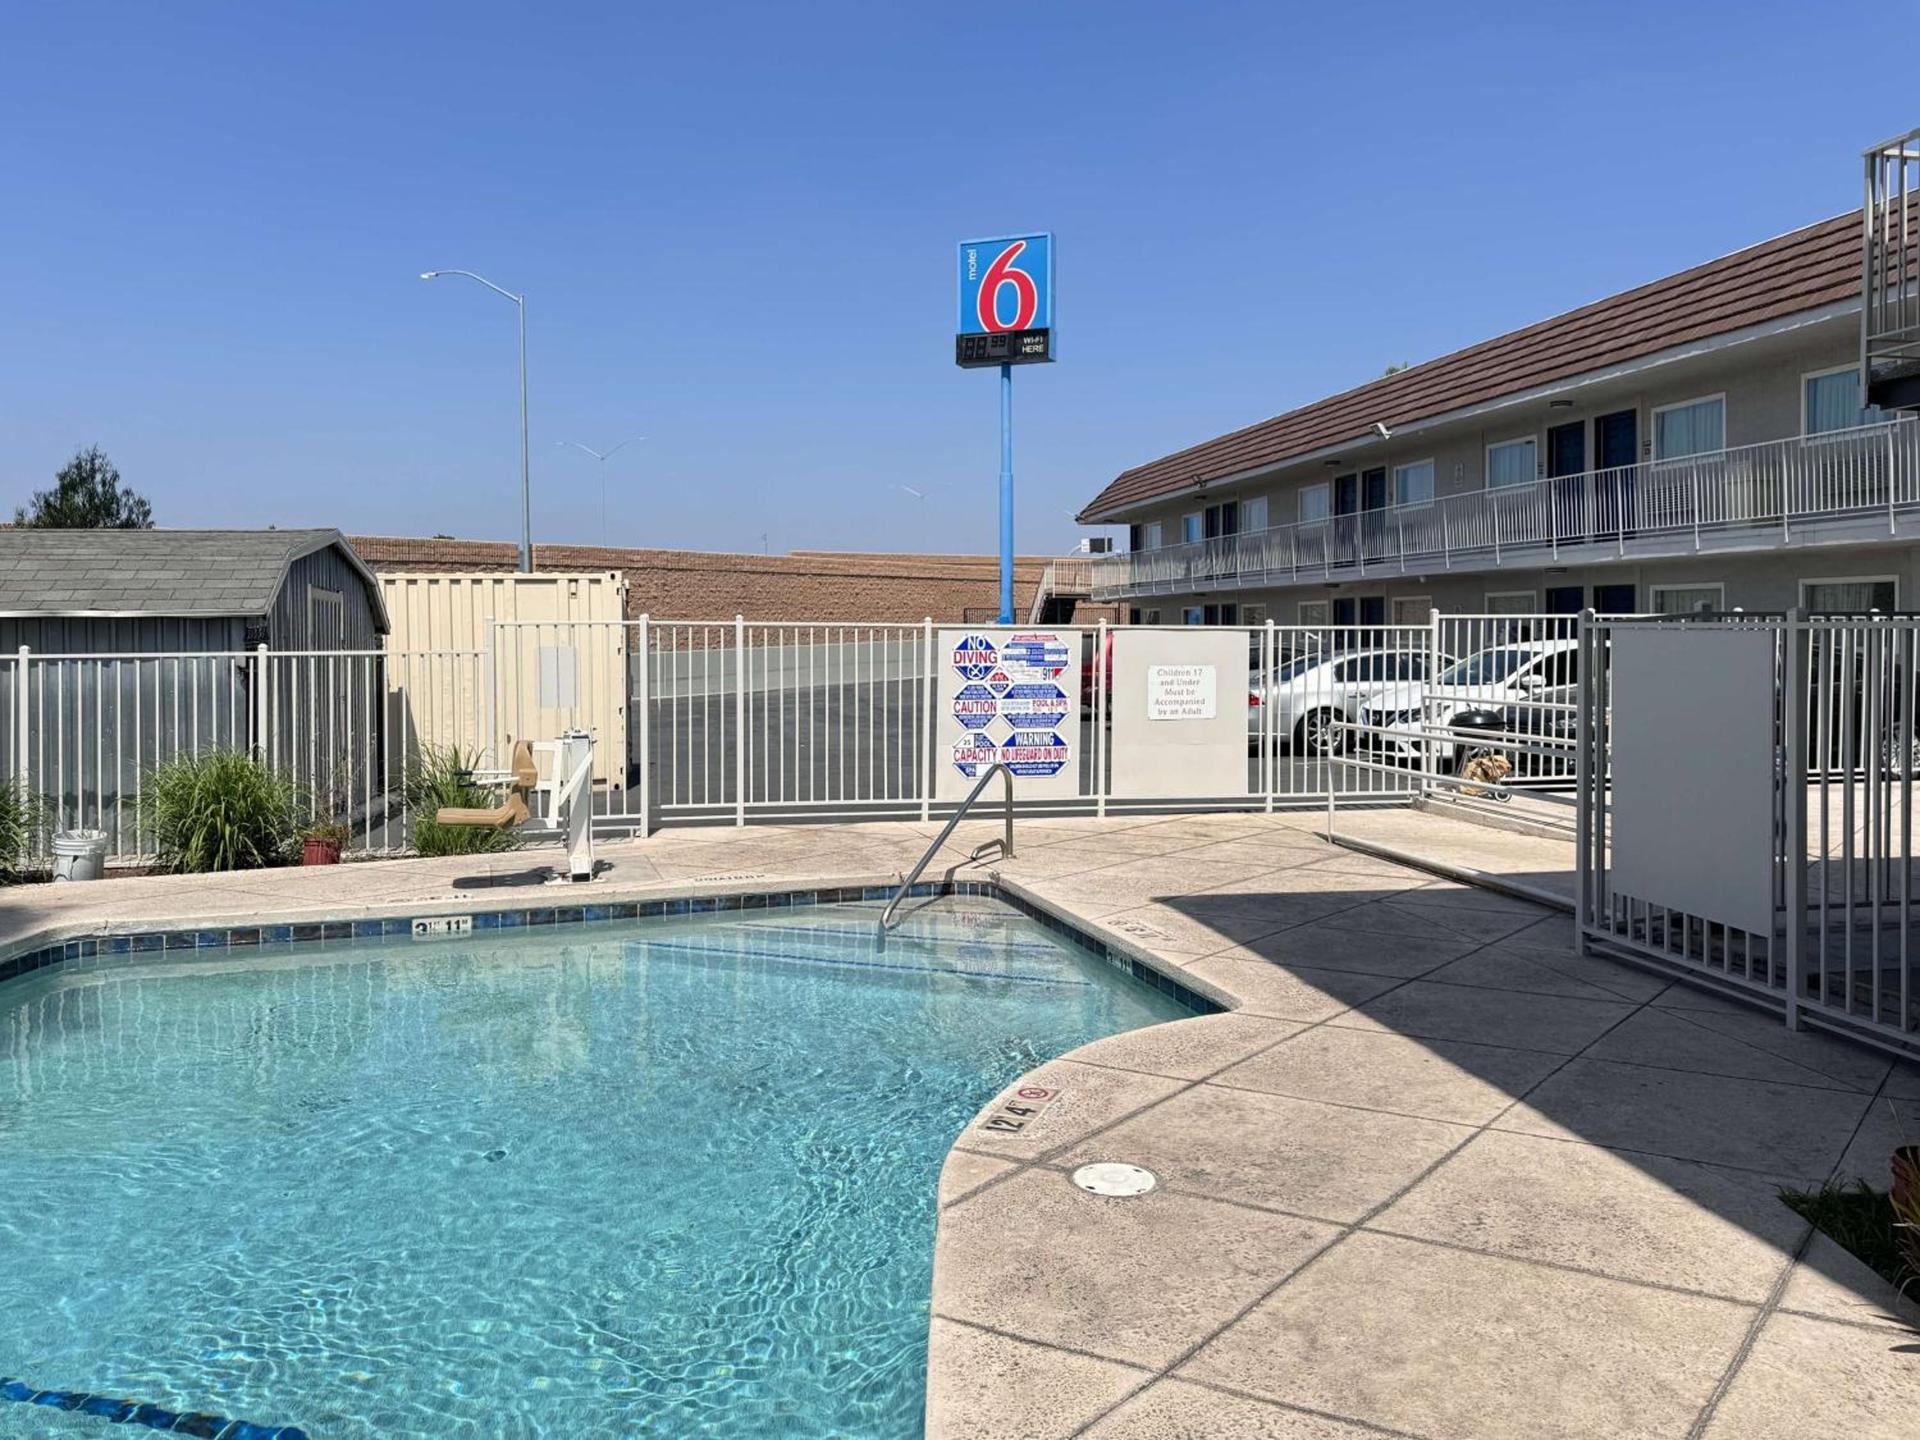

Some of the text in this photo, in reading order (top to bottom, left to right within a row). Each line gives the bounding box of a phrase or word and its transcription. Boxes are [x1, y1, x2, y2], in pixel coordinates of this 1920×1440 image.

[977, 240, 1038, 333] 6
[1022, 344, 1044, 353] HERE
[968, 635, 986, 650] NO
[953, 651, 998, 664] DIVING
[1156, 668, 1203, 677] Children 17
[1176, 678, 1201, 686] Under
[953, 700, 997, 713] CAUTION
[1154, 698, 1206, 707] Accompanied
[1014, 731, 1055, 746] WARNING
[953, 748, 998, 762] CAPACITY
[1000, 746, 1068, 761] NO LIFEGUARD ON DUTY
